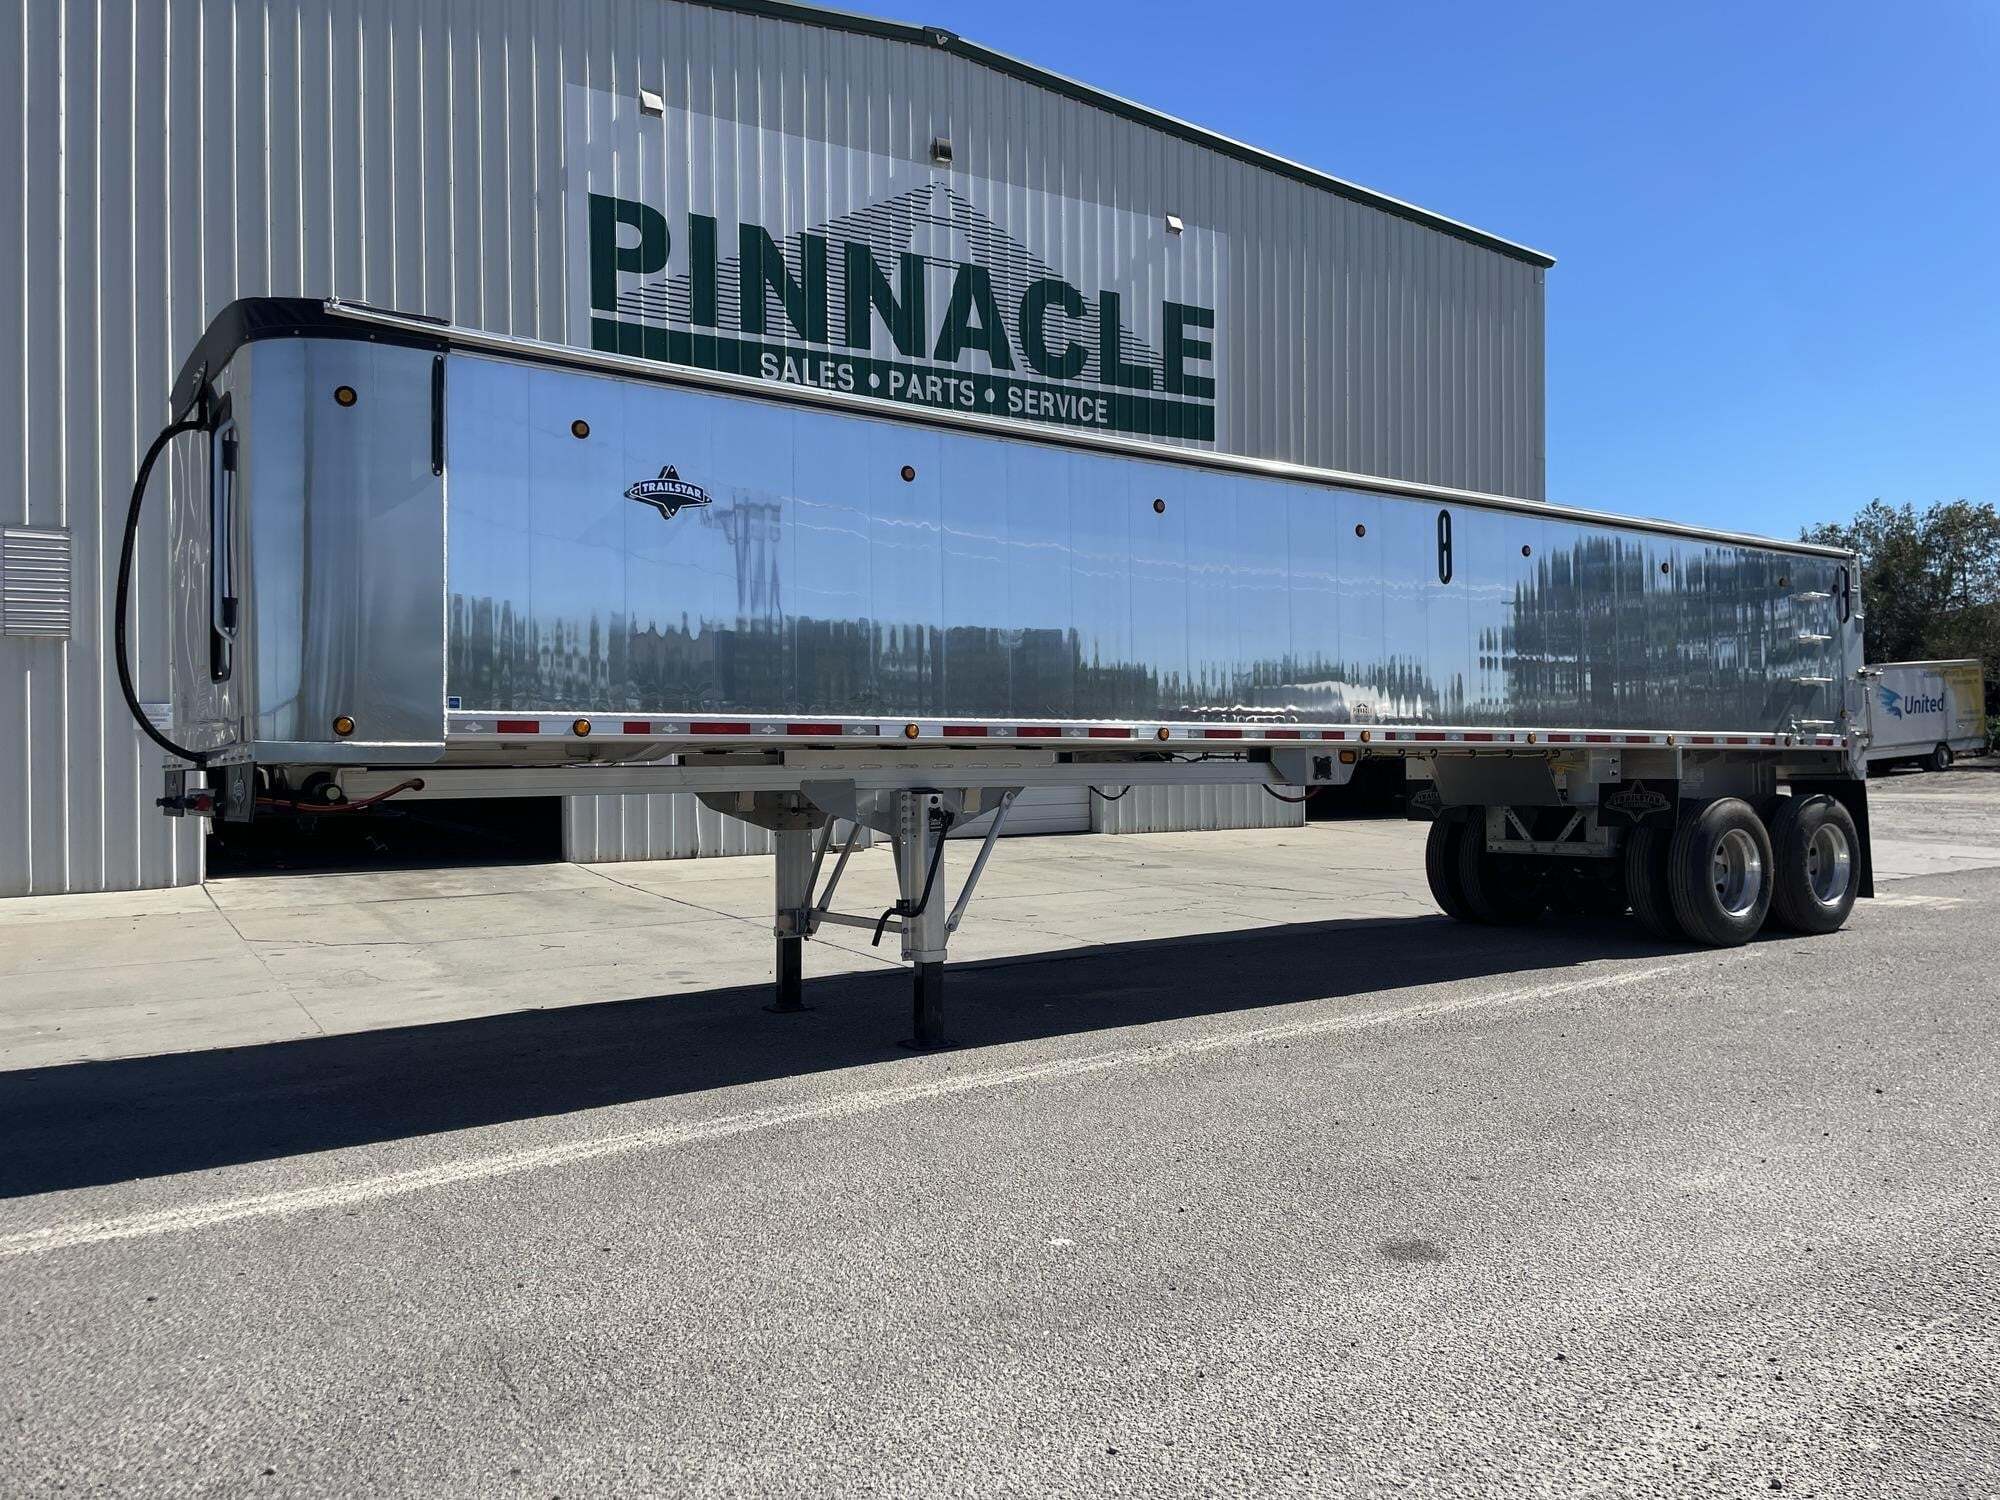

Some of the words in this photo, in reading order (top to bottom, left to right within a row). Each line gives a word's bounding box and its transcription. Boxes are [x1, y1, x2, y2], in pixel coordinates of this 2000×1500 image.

[588, 192, 1215, 400] PINNACLE
[761, 352, 855, 391] SALES
[888, 370, 975, 406] PARTS
[1007, 386, 1108, 424] SERVICE
[641, 482, 702, 499] TRAILSTAR
[1904, 692, 1944, 714] United
